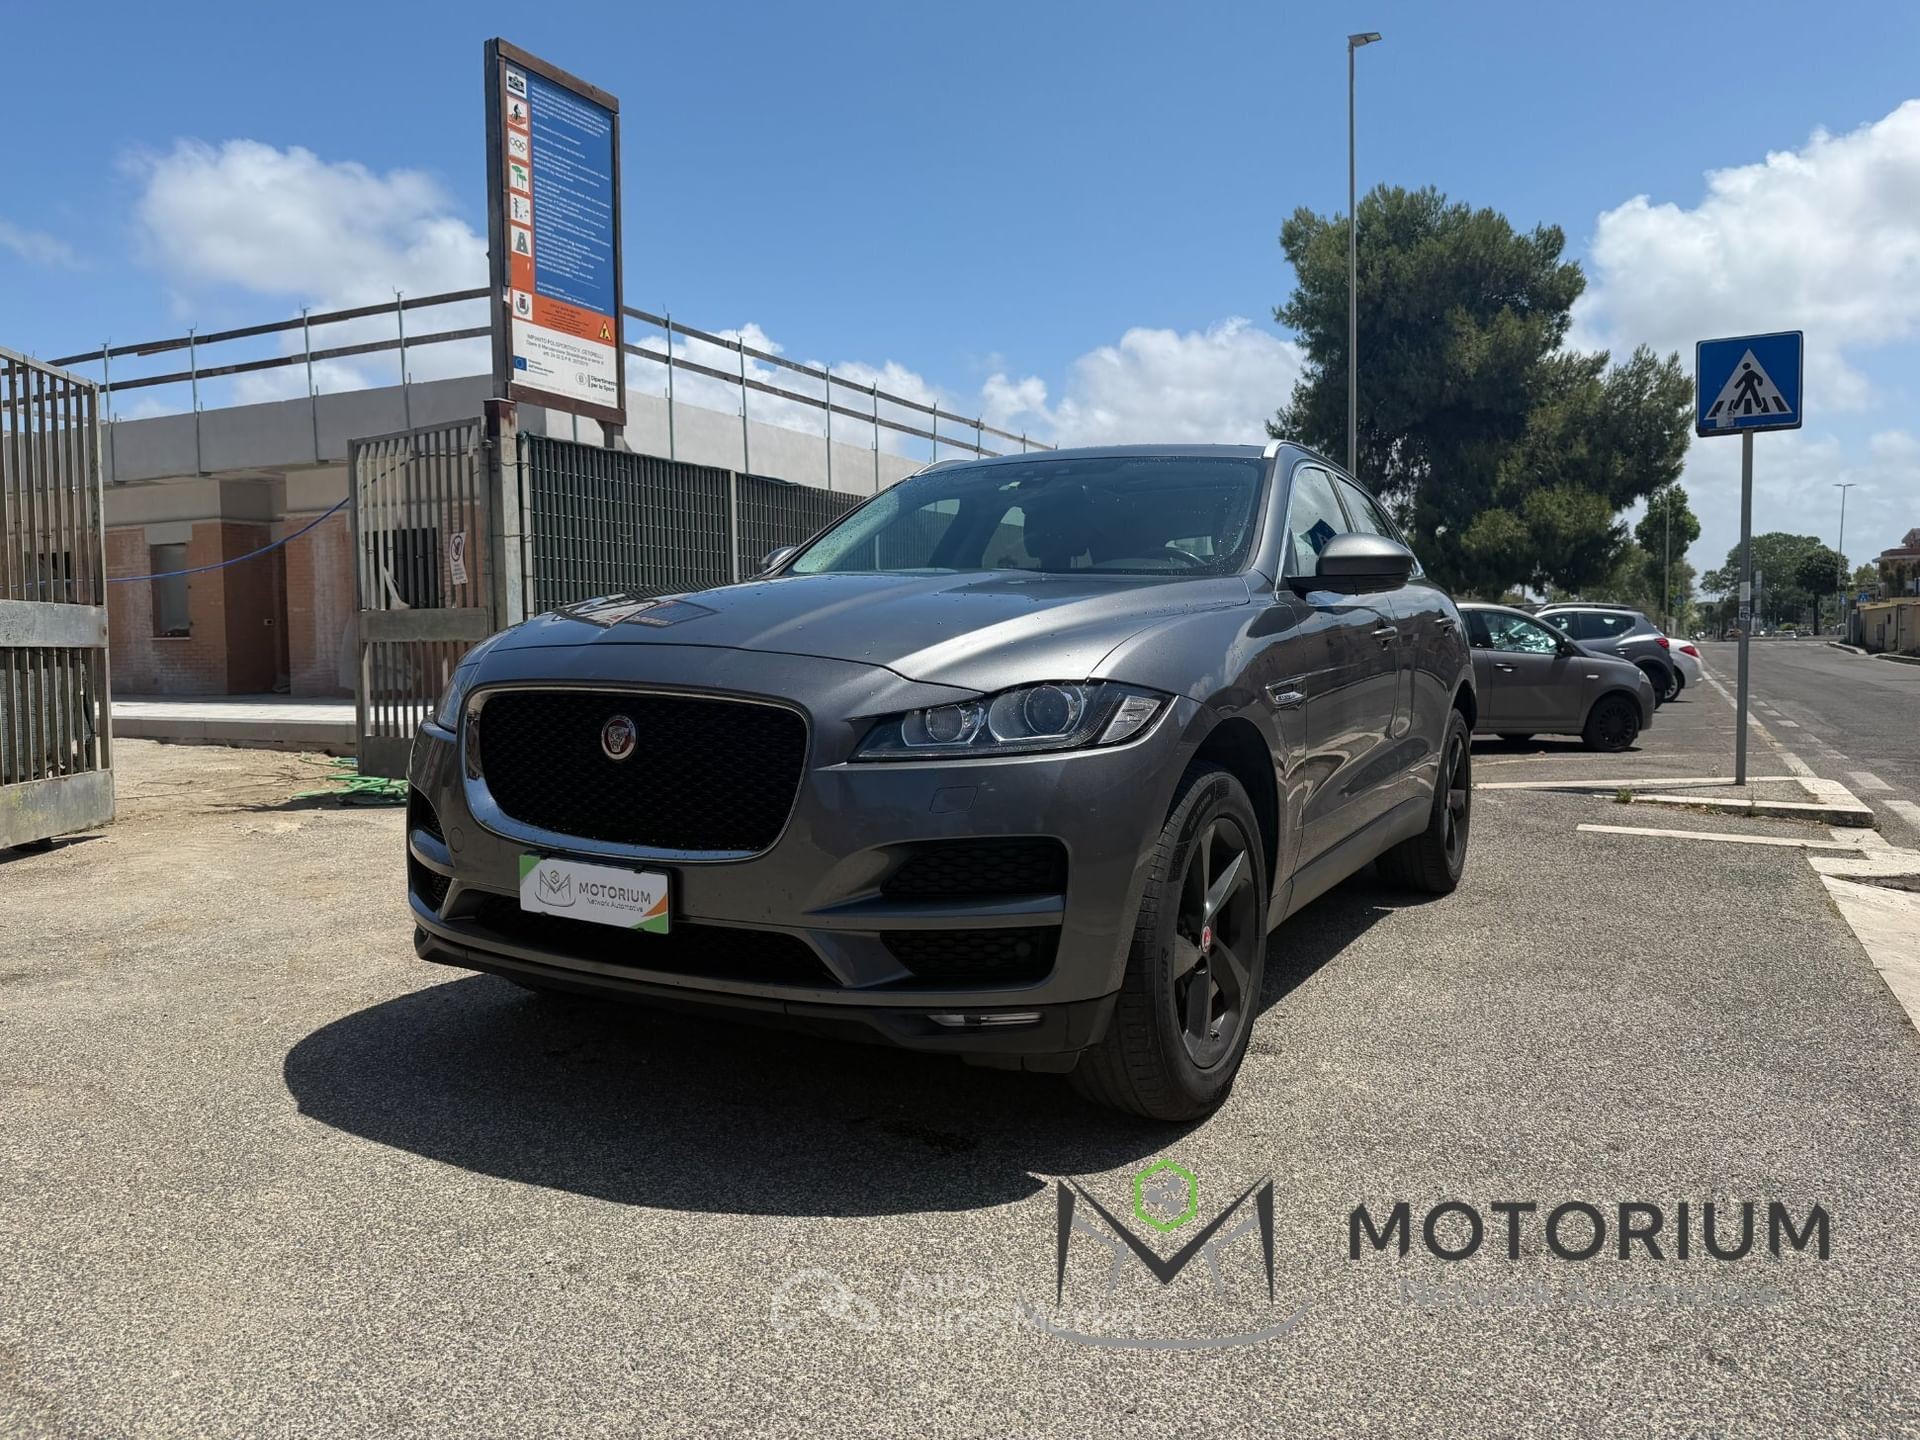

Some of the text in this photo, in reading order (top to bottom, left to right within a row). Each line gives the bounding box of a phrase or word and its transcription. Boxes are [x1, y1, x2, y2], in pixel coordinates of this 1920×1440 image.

[578, 881, 651, 905] MOTORIUM
[587, 897, 643, 913] Network Automotive
